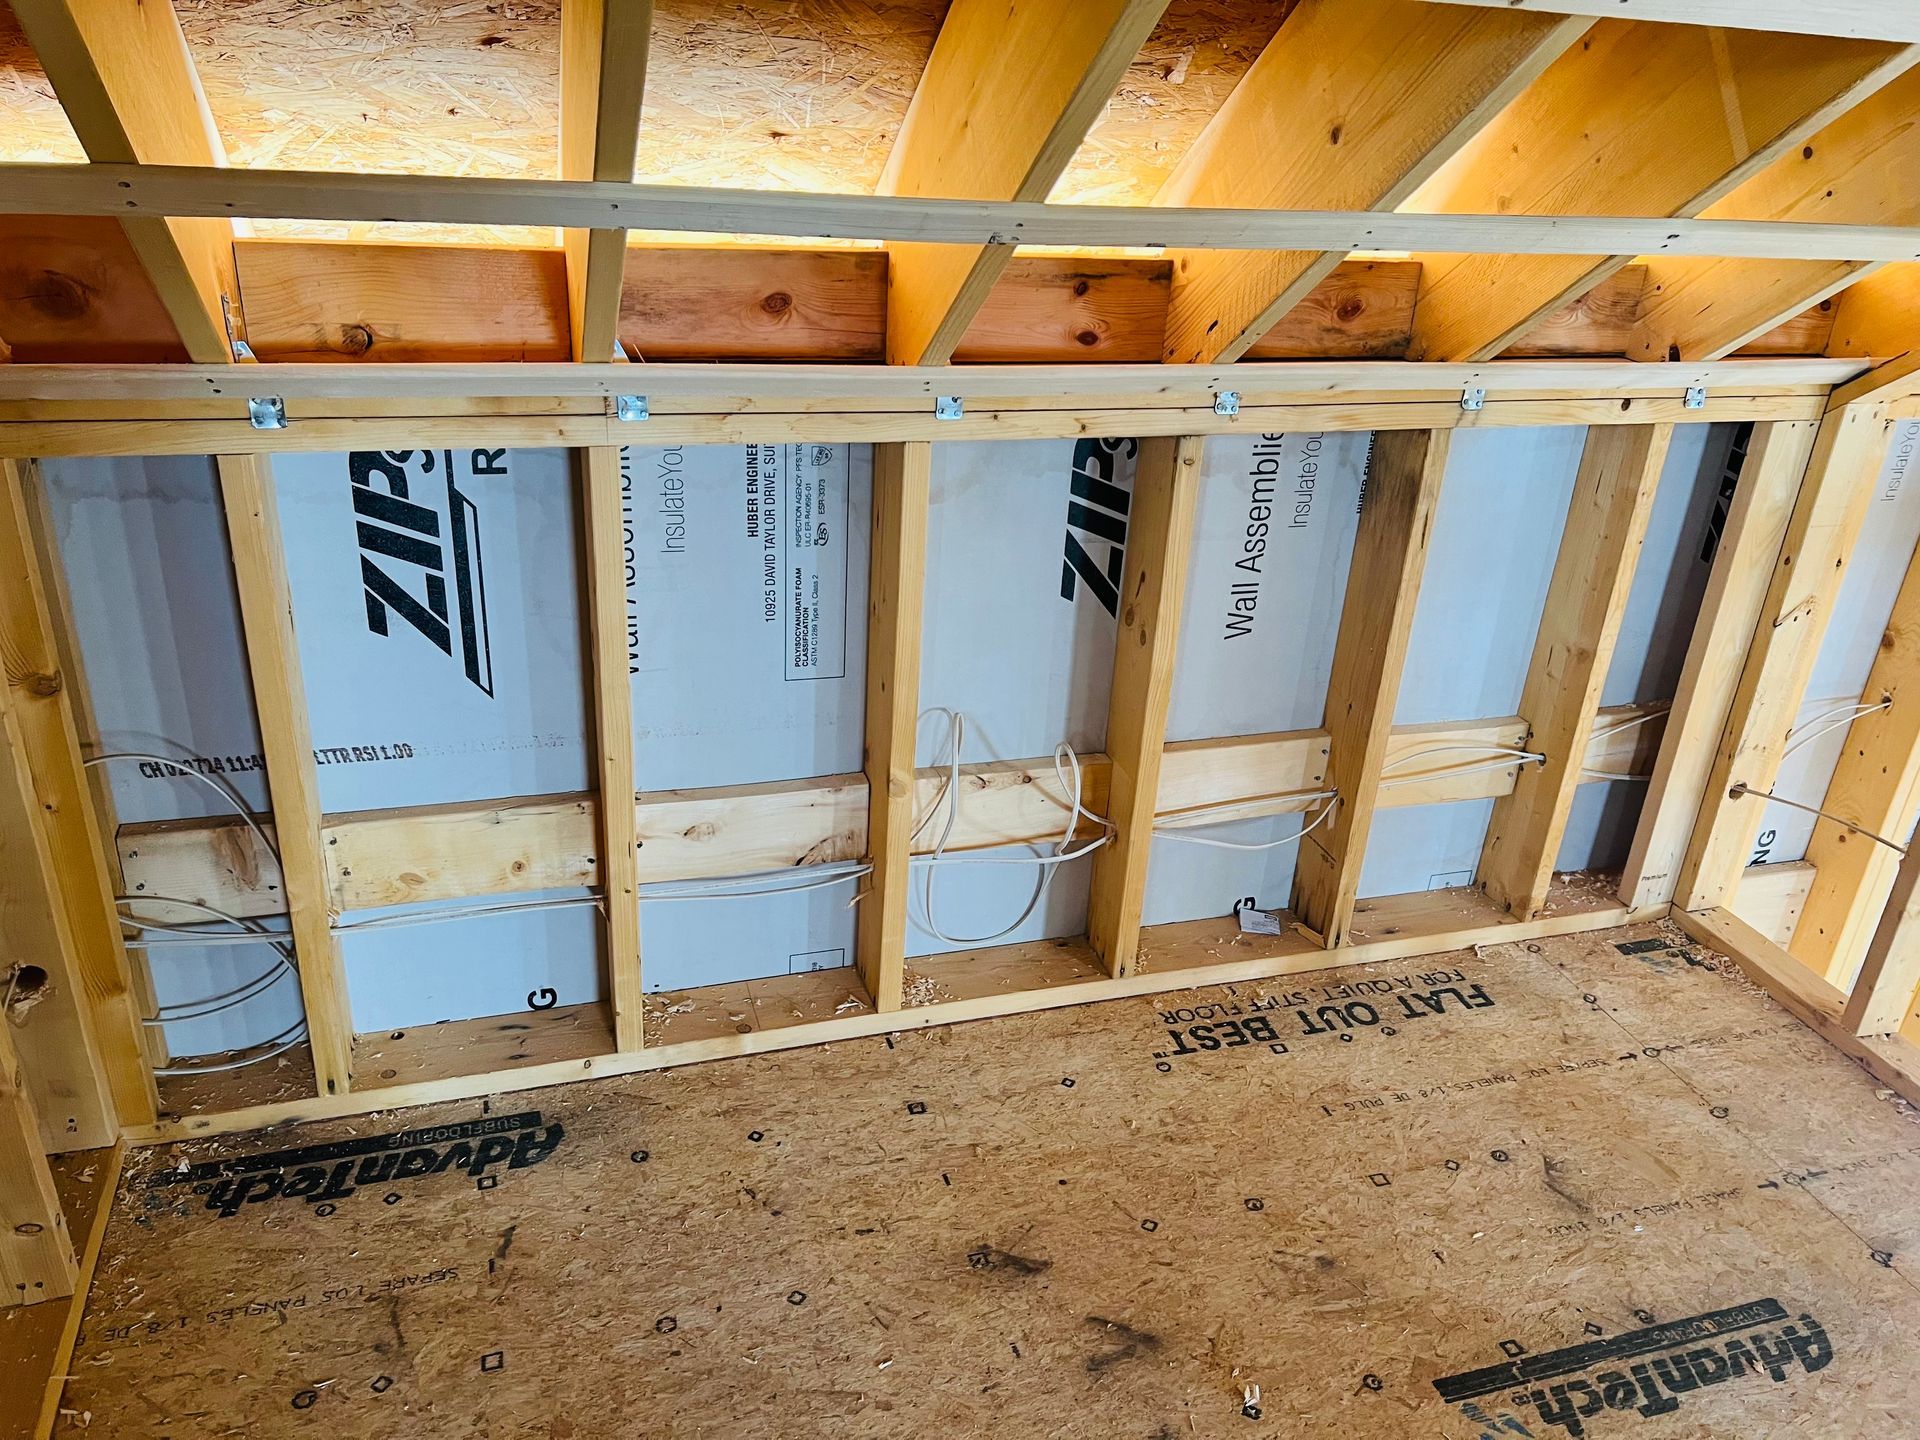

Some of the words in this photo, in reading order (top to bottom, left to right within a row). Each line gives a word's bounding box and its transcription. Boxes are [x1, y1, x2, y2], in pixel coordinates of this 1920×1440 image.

[763, 443, 775, 466] SUI
[763, 468, 777, 505] DRIVE,
[818, 479, 826, 515] ESR-3373
[746, 498, 758, 538] HUBER
[763, 509, 776, 551] TAYLOR
[795, 505, 803, 548] INSPECTION
[764, 553, 776, 586] DAVID
[811, 580, 819, 599] Class
[764, 590, 776, 623] 10925
[811, 607, 820, 623] Type
[1223, 582, 1260, 640] Wall
[794, 591, 802, 668] POLYISOCYANURATE
[810, 624, 818, 646] C1289
[810, 647, 818, 667] ASTM
[351, 745, 381, 762] RSI
[139, 762, 165, 779] CH
[1393, 974, 1414, 989] A
[1416, 968, 1467, 986] FOR
[526, 987, 558, 1011] G
[1248, 990, 1311, 1014] STIFF
[1395, 984, 1496, 1020] FLAT
[1156, 1002, 1242, 1026] FLOOR
[1292, 1001, 1381, 1036] OUT
[1390, 1090, 1411, 1103] DE
[379, 1266, 459, 1293] SEPARE
[206, 1294, 307, 1323] PANELES
[103, 1326, 131, 1344] DE
[146, 1316, 190, 1334] 1/8
